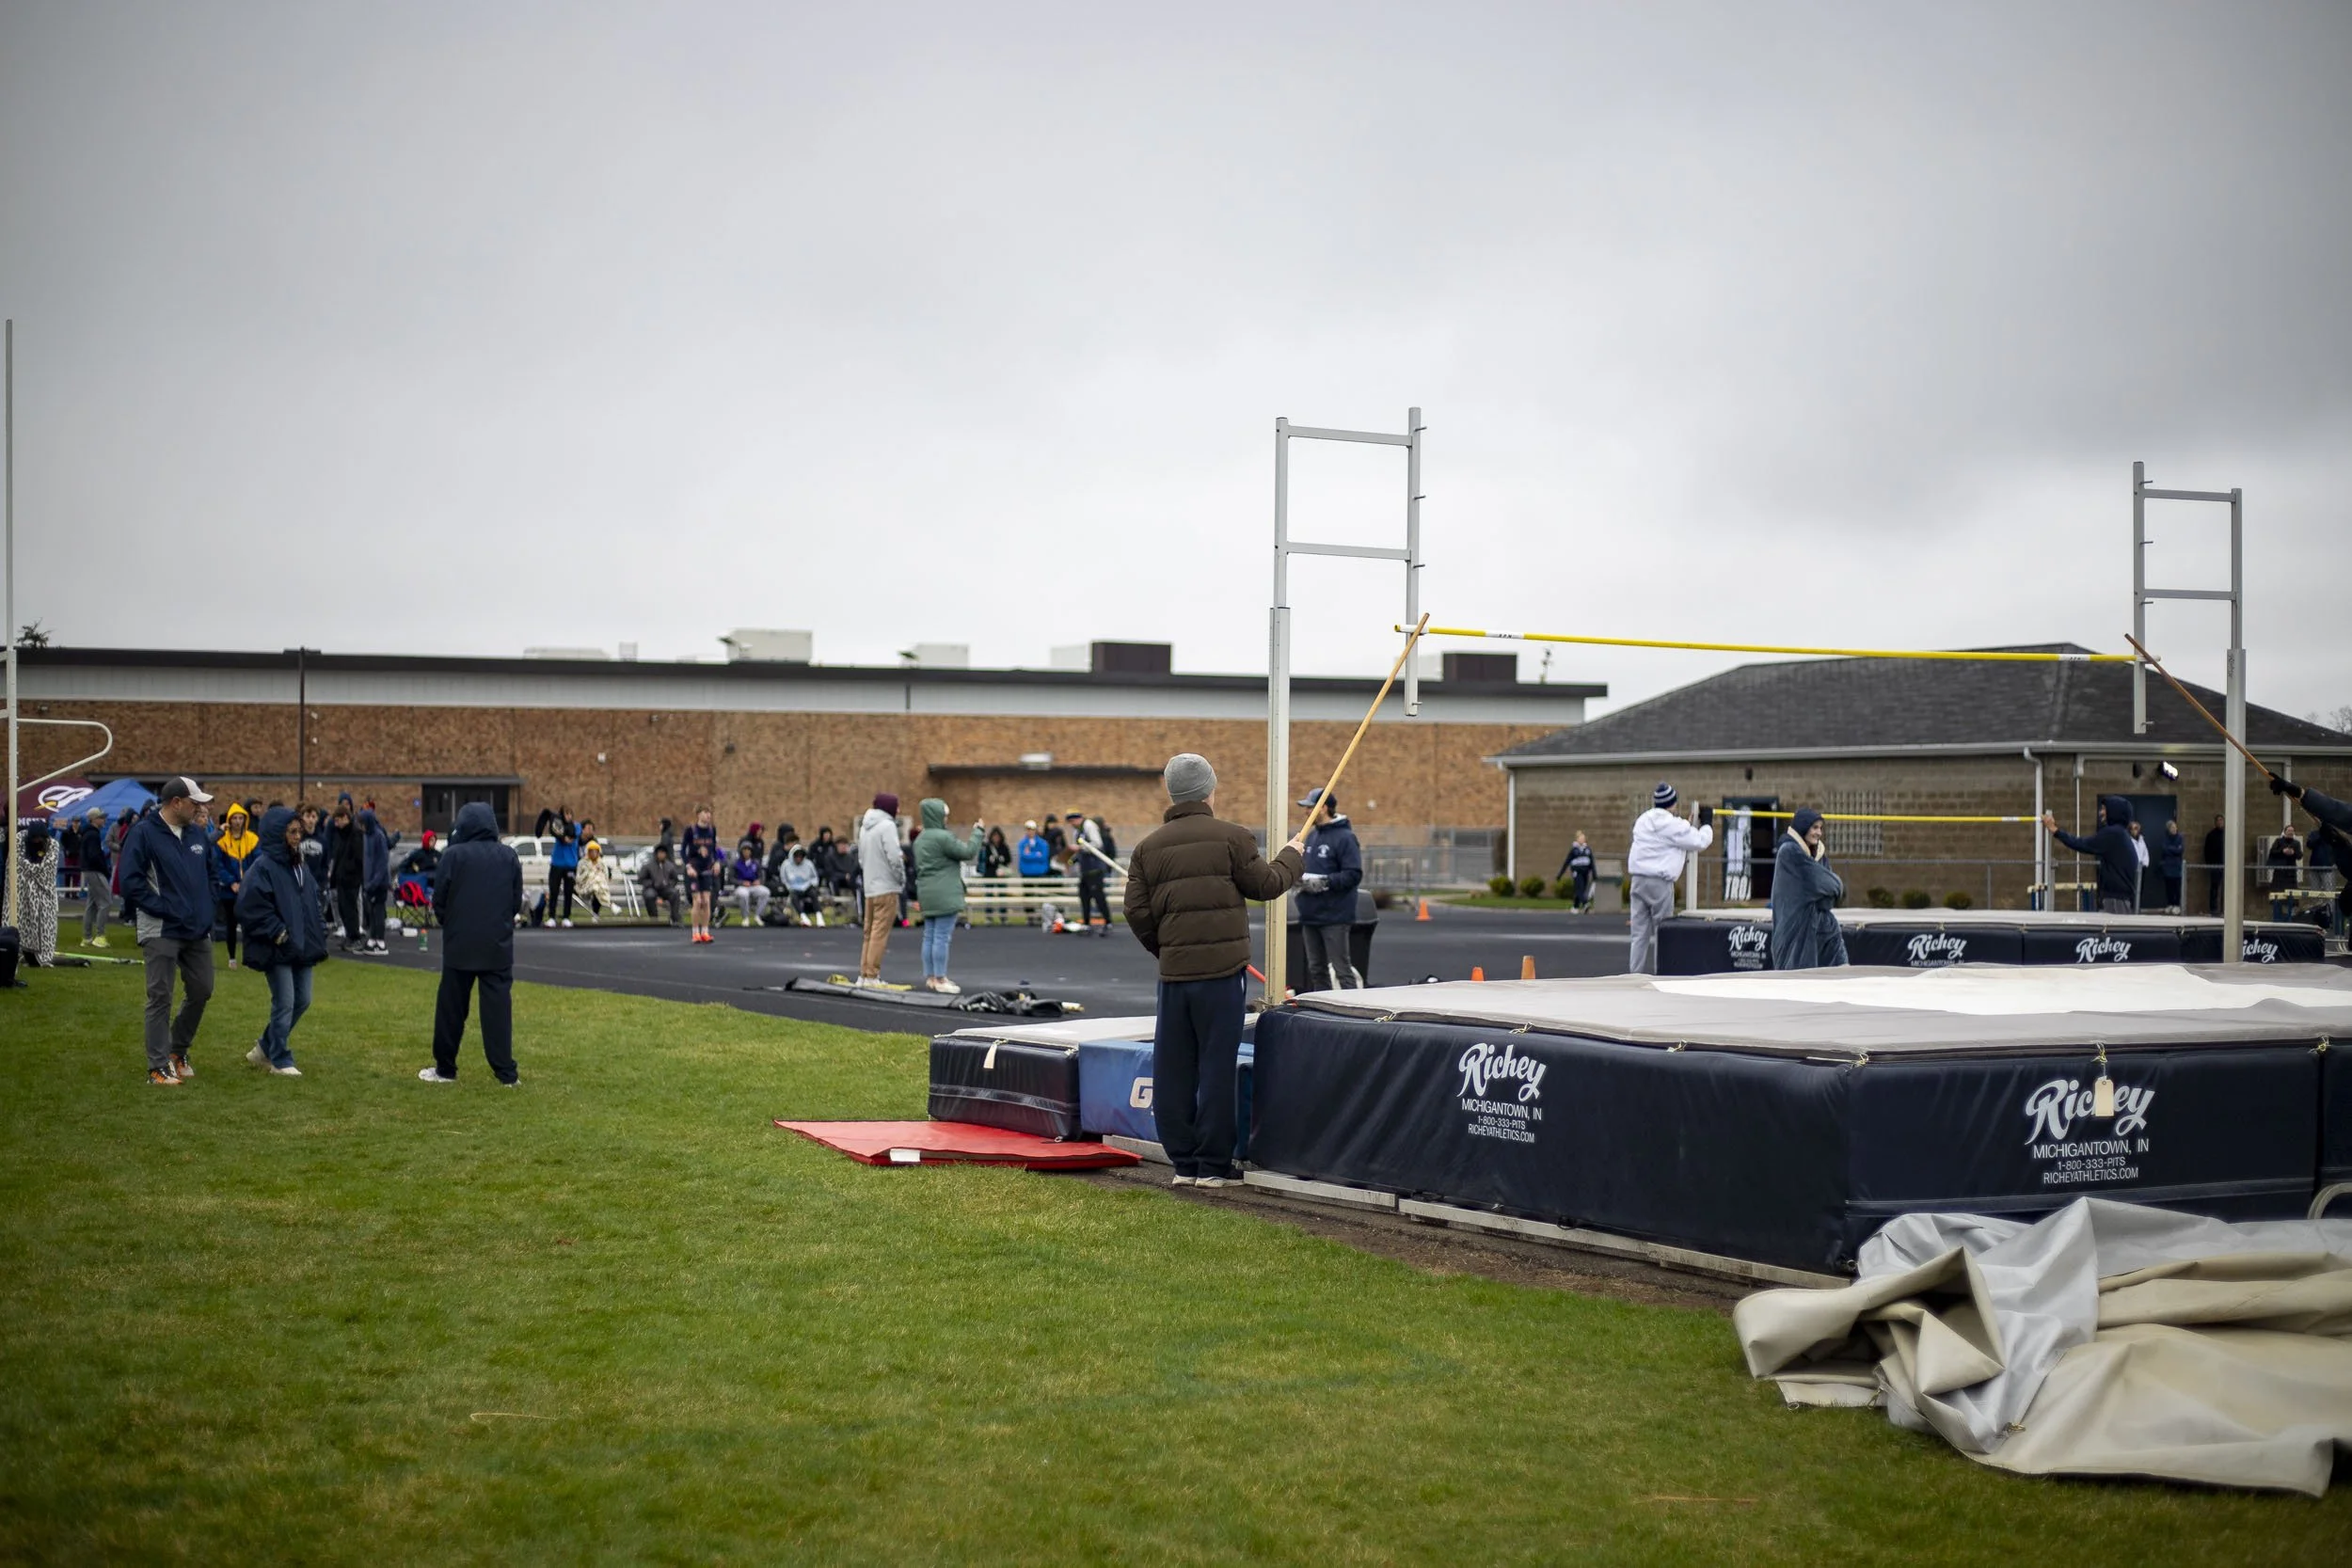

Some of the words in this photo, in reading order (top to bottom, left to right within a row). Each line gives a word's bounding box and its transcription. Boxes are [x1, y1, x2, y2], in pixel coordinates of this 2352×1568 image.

[1728, 926, 1768, 952] Richey
[1907, 933, 1967, 961] Richey
[2075, 937, 2132, 963] Richey
[2243, 939, 2278, 963] ichey
[1456, 1042, 1547, 1101] Richey
[1462, 1098, 1530, 1121] MICHIGANTOWN,
[1533, 1108, 1542, 1121] IN
[2025, 1079, 2155, 1146] Ricey
[1468, 1123, 1535, 1143] RICHEYATHLETICS.COM
[1477, 1116, 1526, 1130] 1-800-333-PITS
[2033, 1139, 2132, 1159] MICHIGANTOWN,
[2137, 1138, 2149, 1152] IN
[2057, 1156, 2126, 1170] 1-800-333-PITS
[2043, 1167, 2138, 1184] RICHEYATHLETICS.COM
